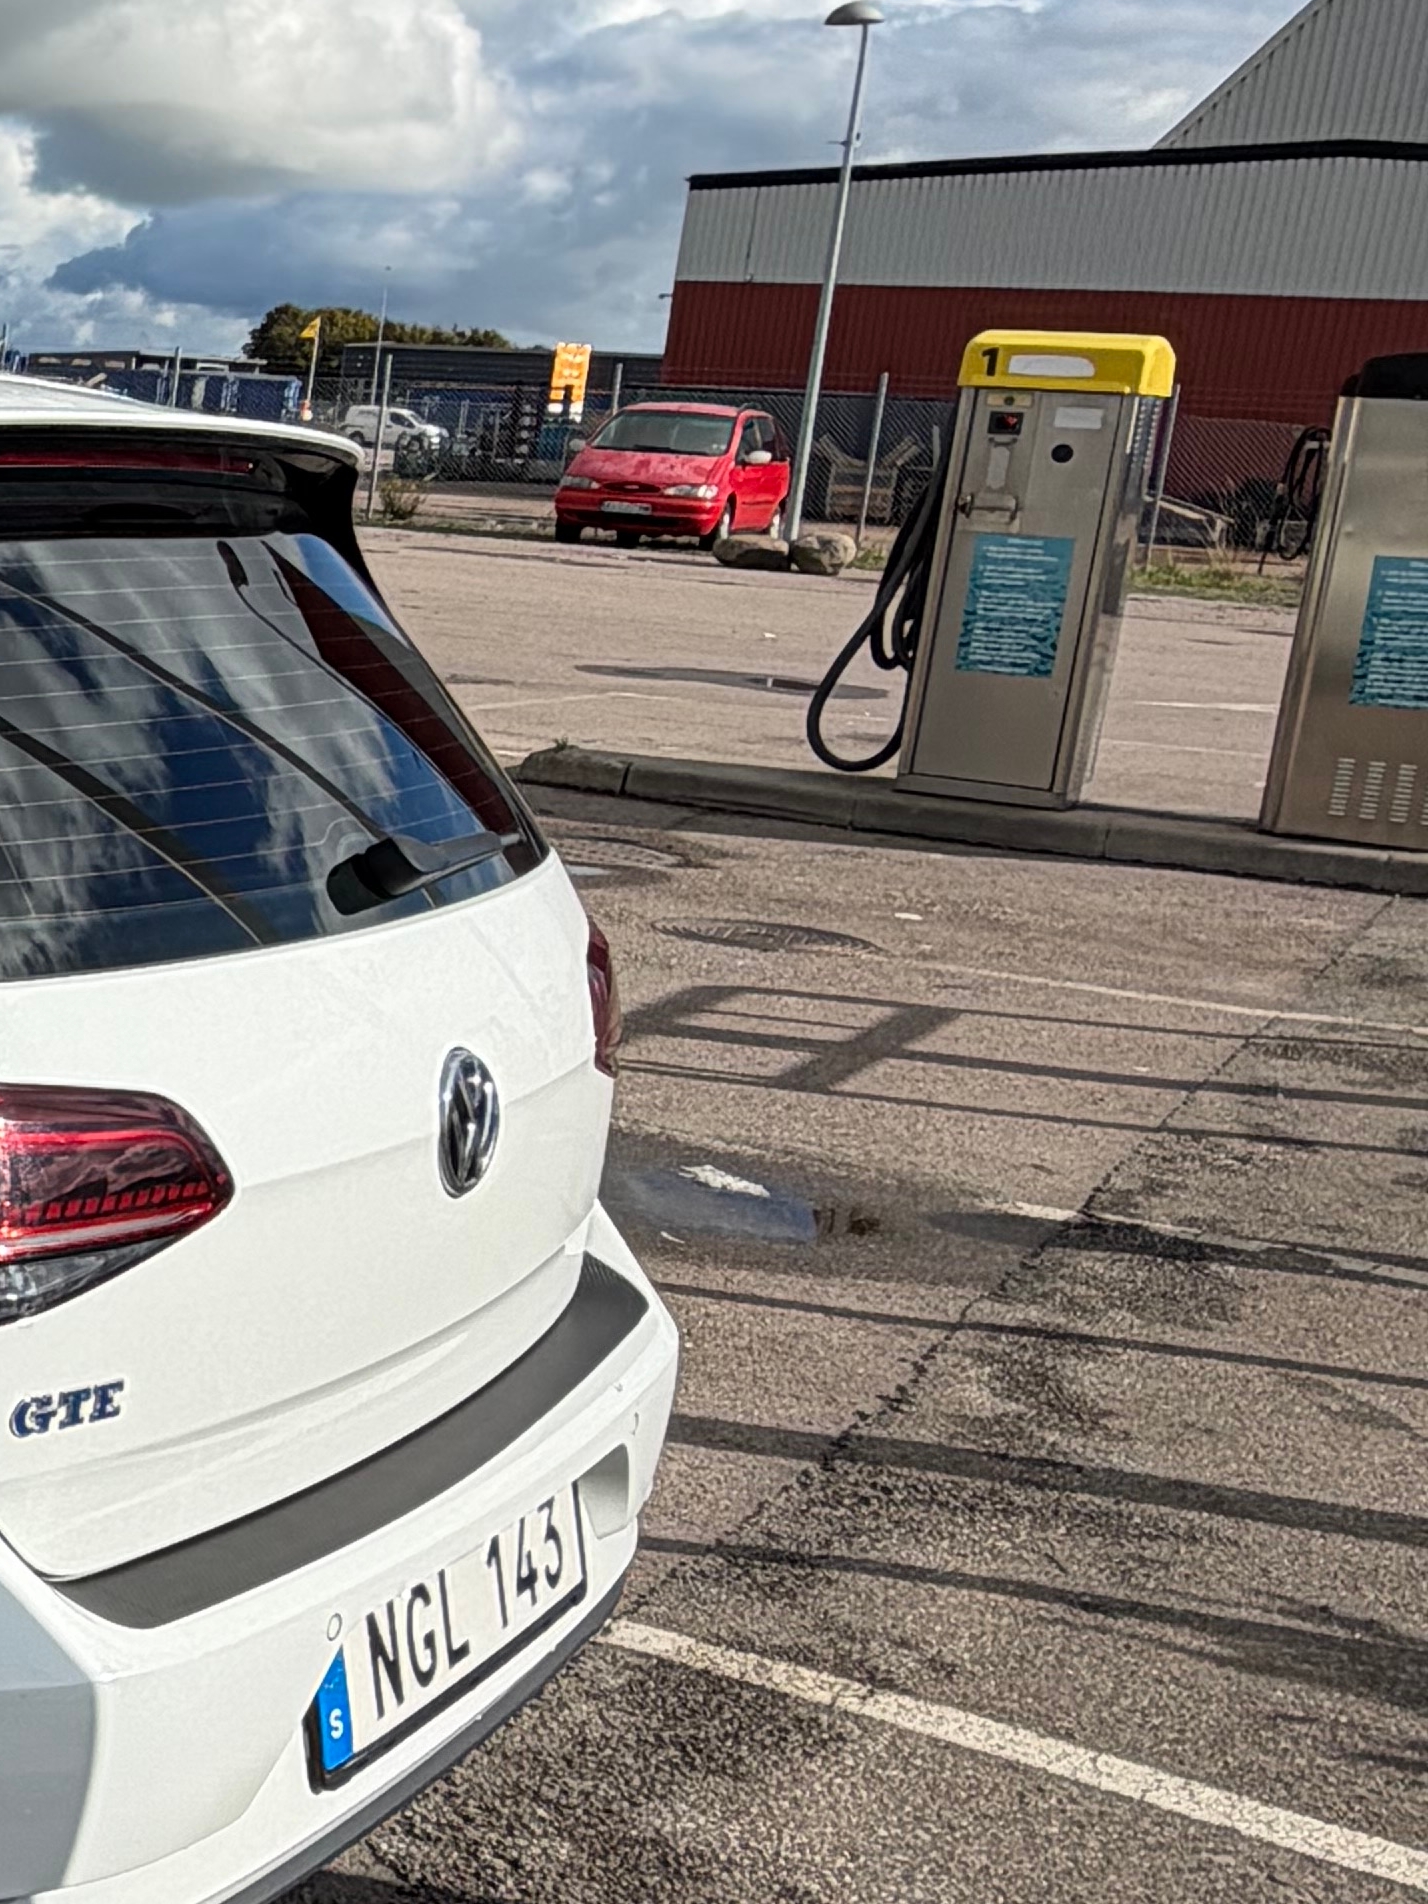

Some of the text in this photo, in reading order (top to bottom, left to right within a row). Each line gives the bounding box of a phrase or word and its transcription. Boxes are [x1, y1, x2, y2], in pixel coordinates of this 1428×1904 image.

[981, 346, 1000, 377] 1
[8, 1377, 125, 1438] GTE
[328, 1494, 564, 1740] S NGL 143
